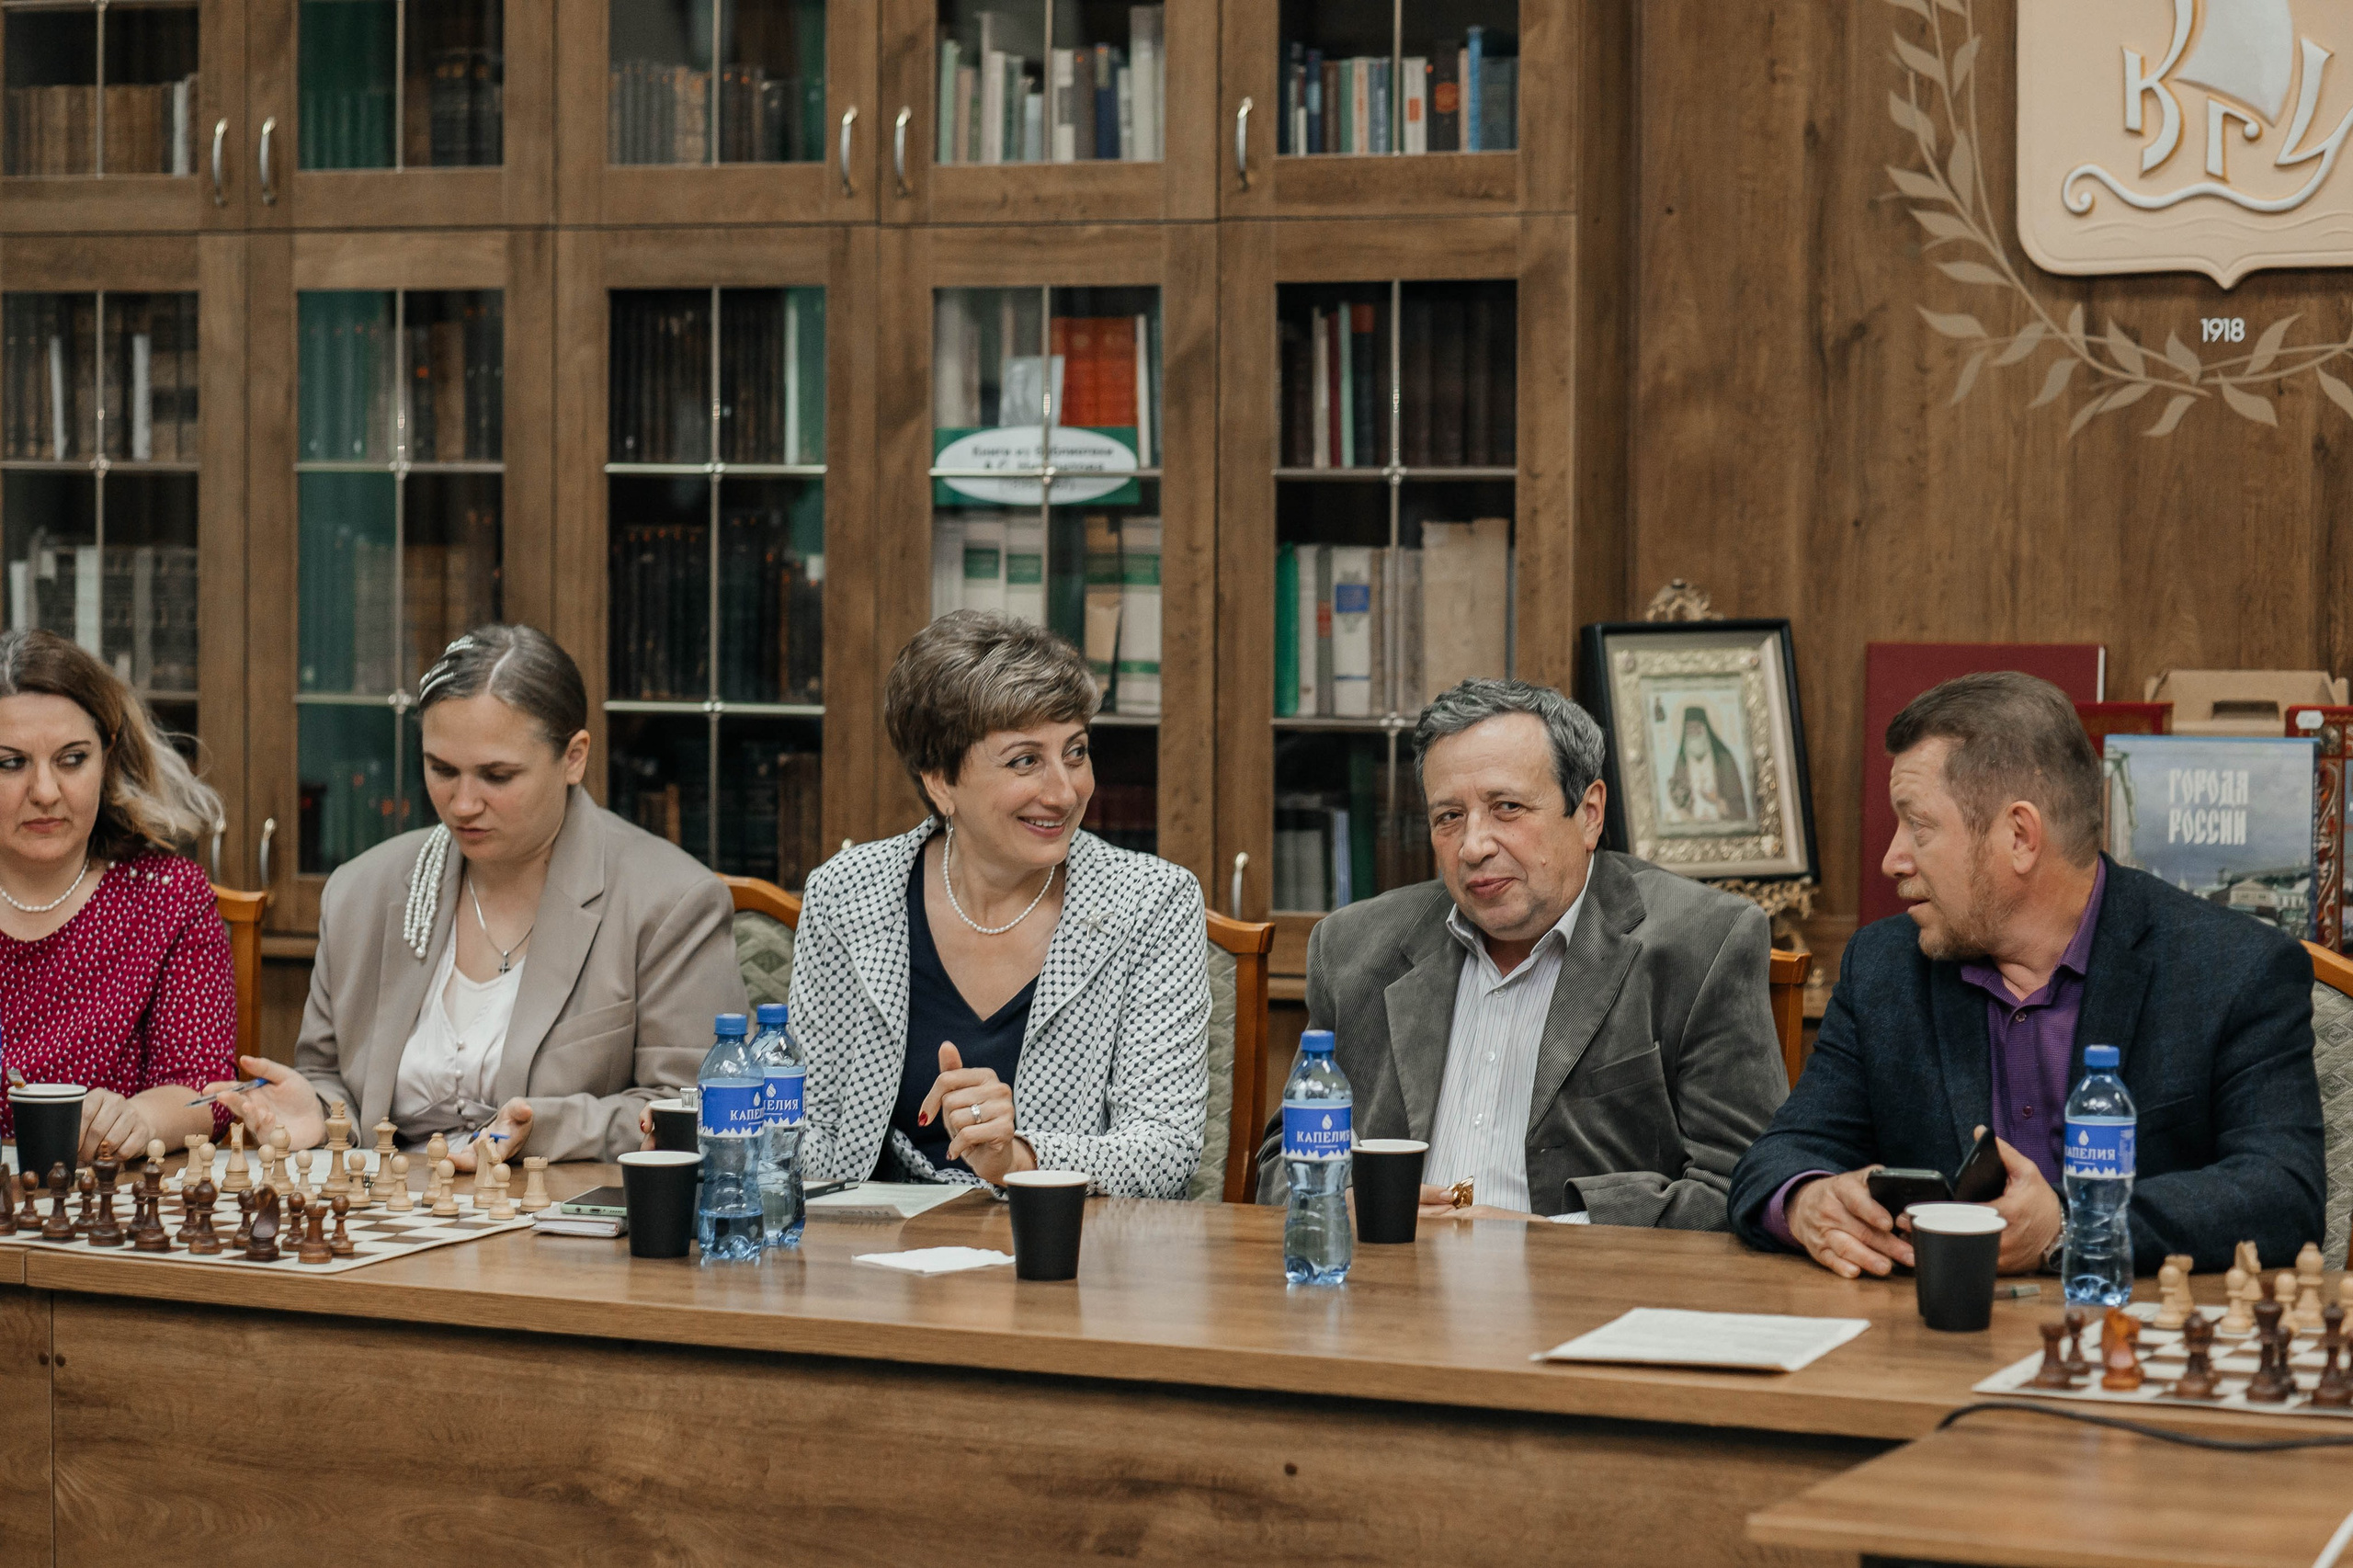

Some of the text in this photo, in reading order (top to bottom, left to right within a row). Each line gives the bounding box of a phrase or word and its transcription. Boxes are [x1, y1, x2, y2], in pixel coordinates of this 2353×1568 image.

[2200, 317, 2245, 343] 1918
[2169, 768, 2248, 808] ГОРОДА
[2168, 808, 2247, 846] РОССИИ
